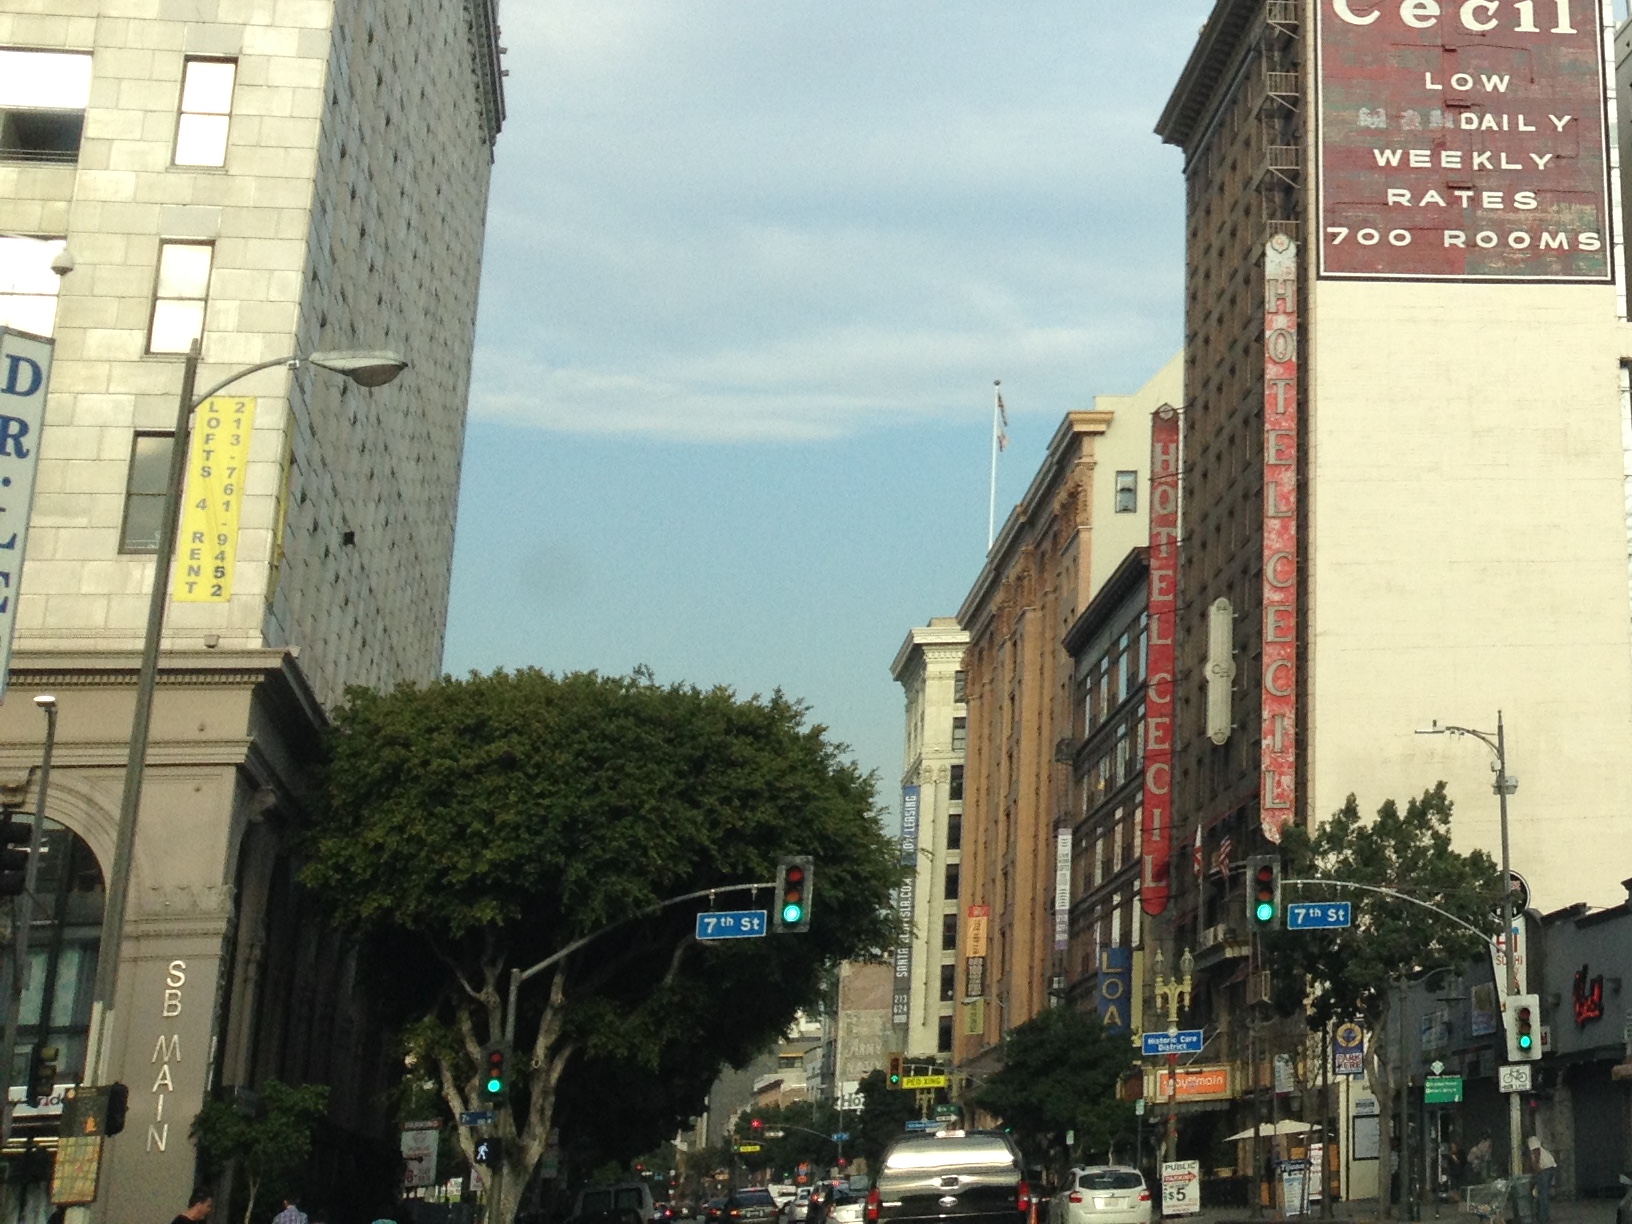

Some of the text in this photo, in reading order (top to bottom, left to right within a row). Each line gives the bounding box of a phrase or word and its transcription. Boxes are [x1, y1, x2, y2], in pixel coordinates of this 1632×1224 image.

[1425, 72, 1511, 93] LOW
[1460, 112, 1573, 132] DAILY
[1373, 148, 1554, 171] WEEKLY
[1387, 188, 1539, 210] RATES
[1326, 227, 1602, 252] 700 ROOMS
[185, 400, 221, 594] LOFTS 4 RENT
[210, 401, 246, 597] 213-761-9452
[1263, 279, 1295, 811] HOTEL CECIL
[1142, 441, 1177, 888] HOTEL CECIL
[904, 795, 917, 832] LEASING
[704, 917, 760, 934] 7th St
[1295, 908, 1345, 925] 7th St
[1495, 955, 1523, 966] SUHI
[1102, 951, 1124, 1026] LOA
[146, 960, 187, 1153] SB MAIN
[1165, 1162, 1196, 1171] PUBLIC
